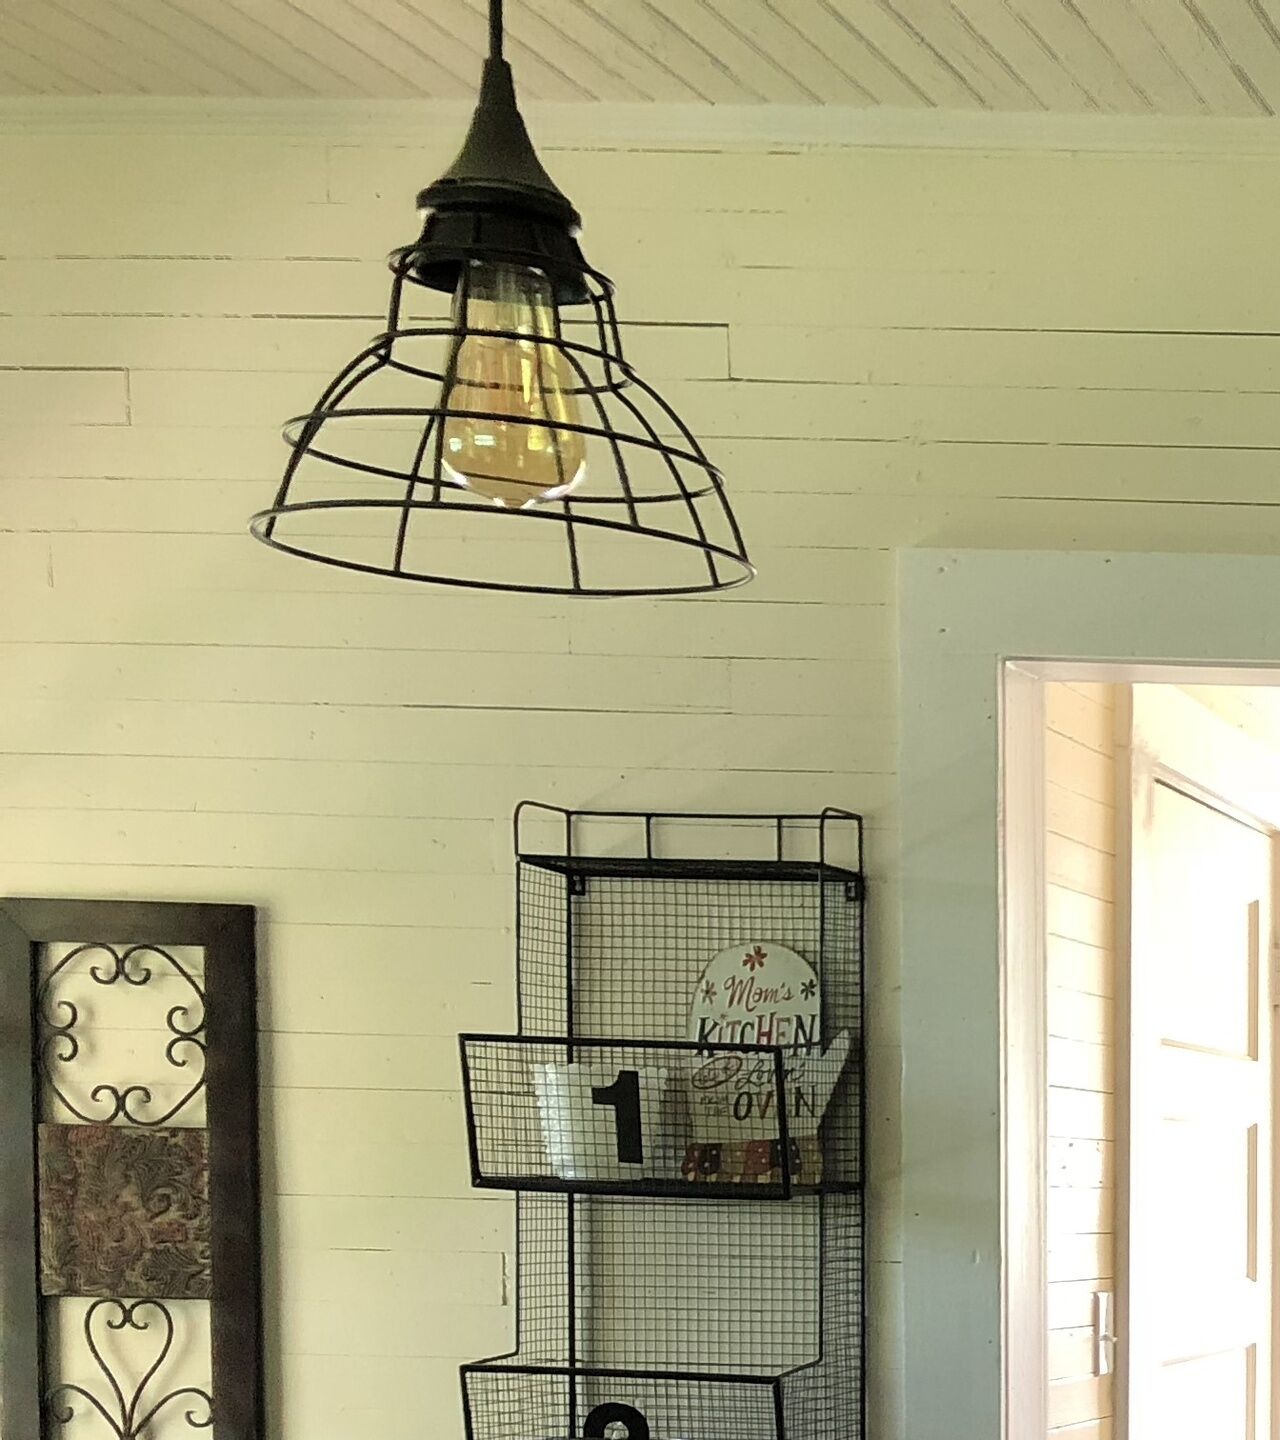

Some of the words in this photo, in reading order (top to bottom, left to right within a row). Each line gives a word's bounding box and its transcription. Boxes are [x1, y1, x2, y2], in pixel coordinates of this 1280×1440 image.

[723, 975, 794, 1012] Mom's
[592, 1070, 643, 1164] 1
[733, 1085, 816, 1121] OVN
